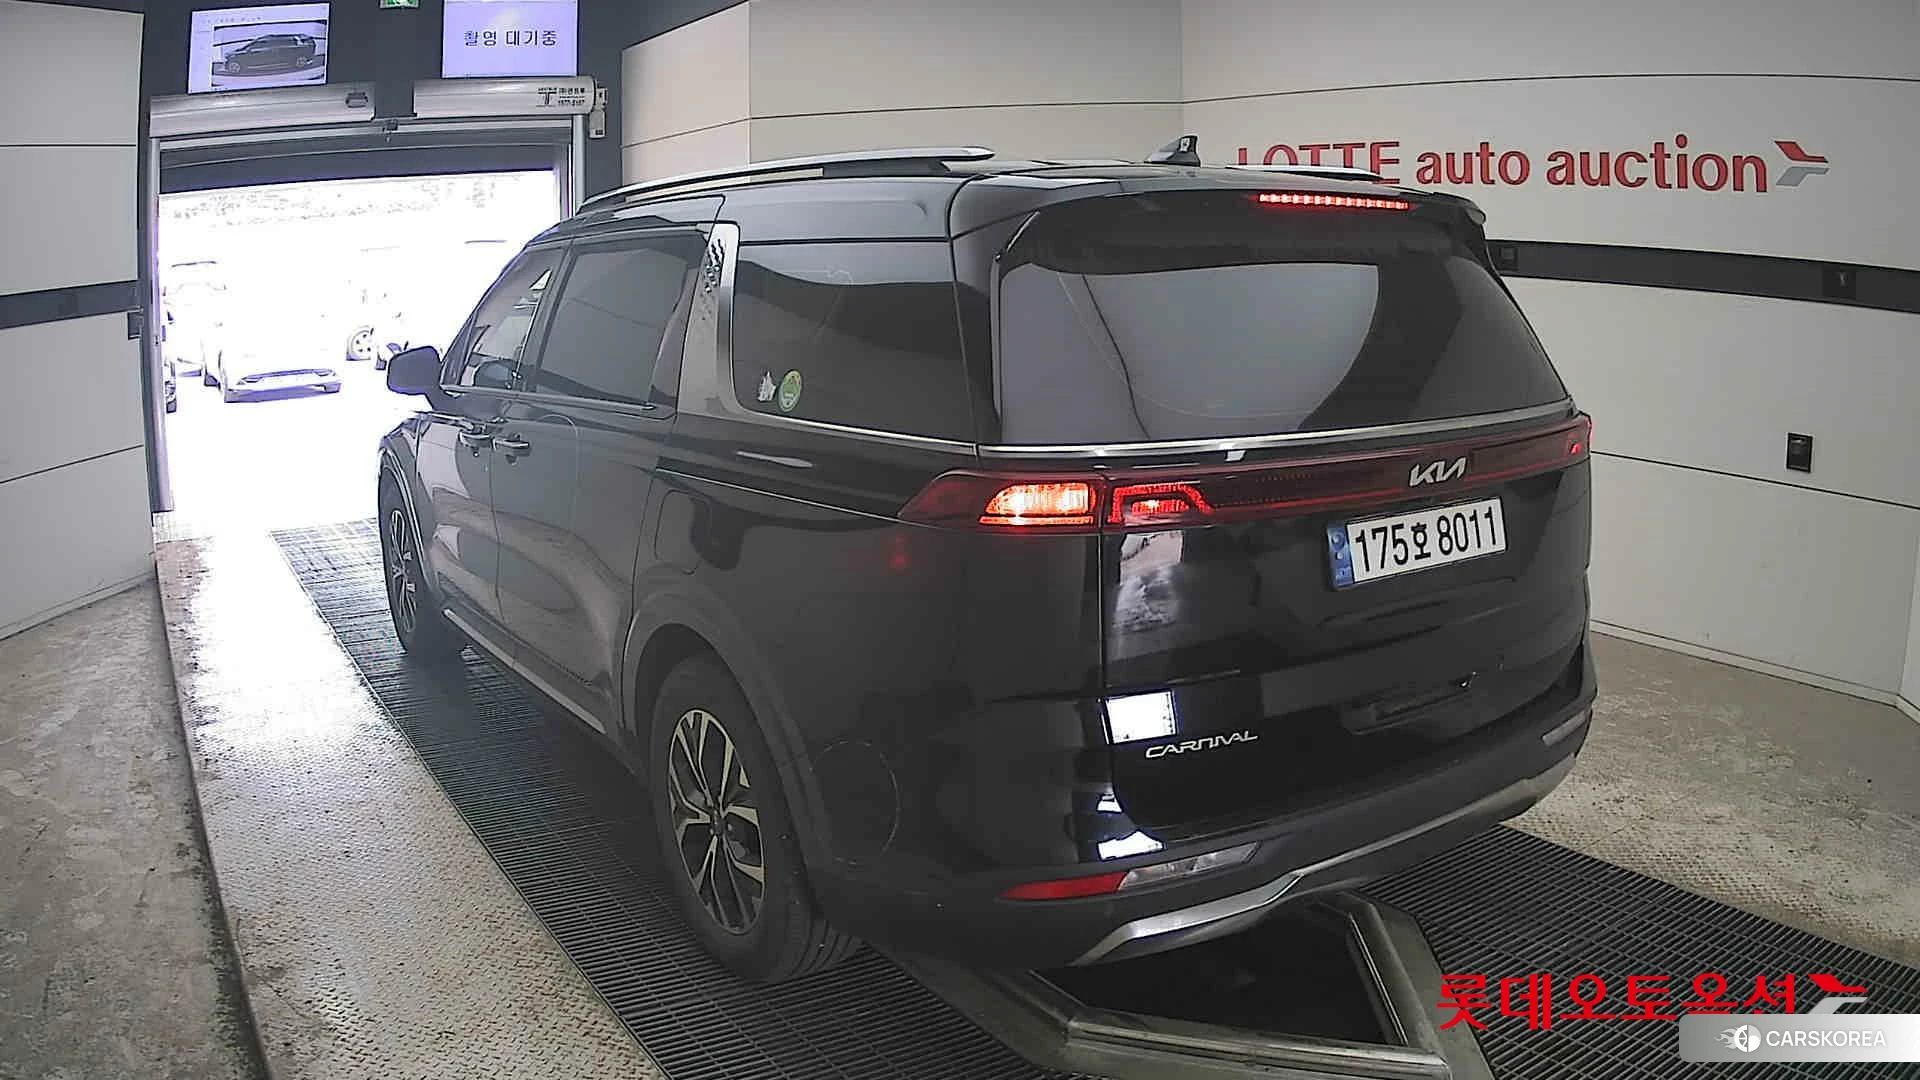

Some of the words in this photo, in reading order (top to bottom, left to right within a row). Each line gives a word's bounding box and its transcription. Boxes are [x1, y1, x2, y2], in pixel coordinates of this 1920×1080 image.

[505, 30, 556, 47] 대기중
[1415, 142, 1531, 186] auto
[1546, 134, 1768, 193] auction
[1355, 522, 1432, 573] 175호
[1436, 506, 1497, 556] 8011
[1145, 730, 1259, 759] CARNIVAL
